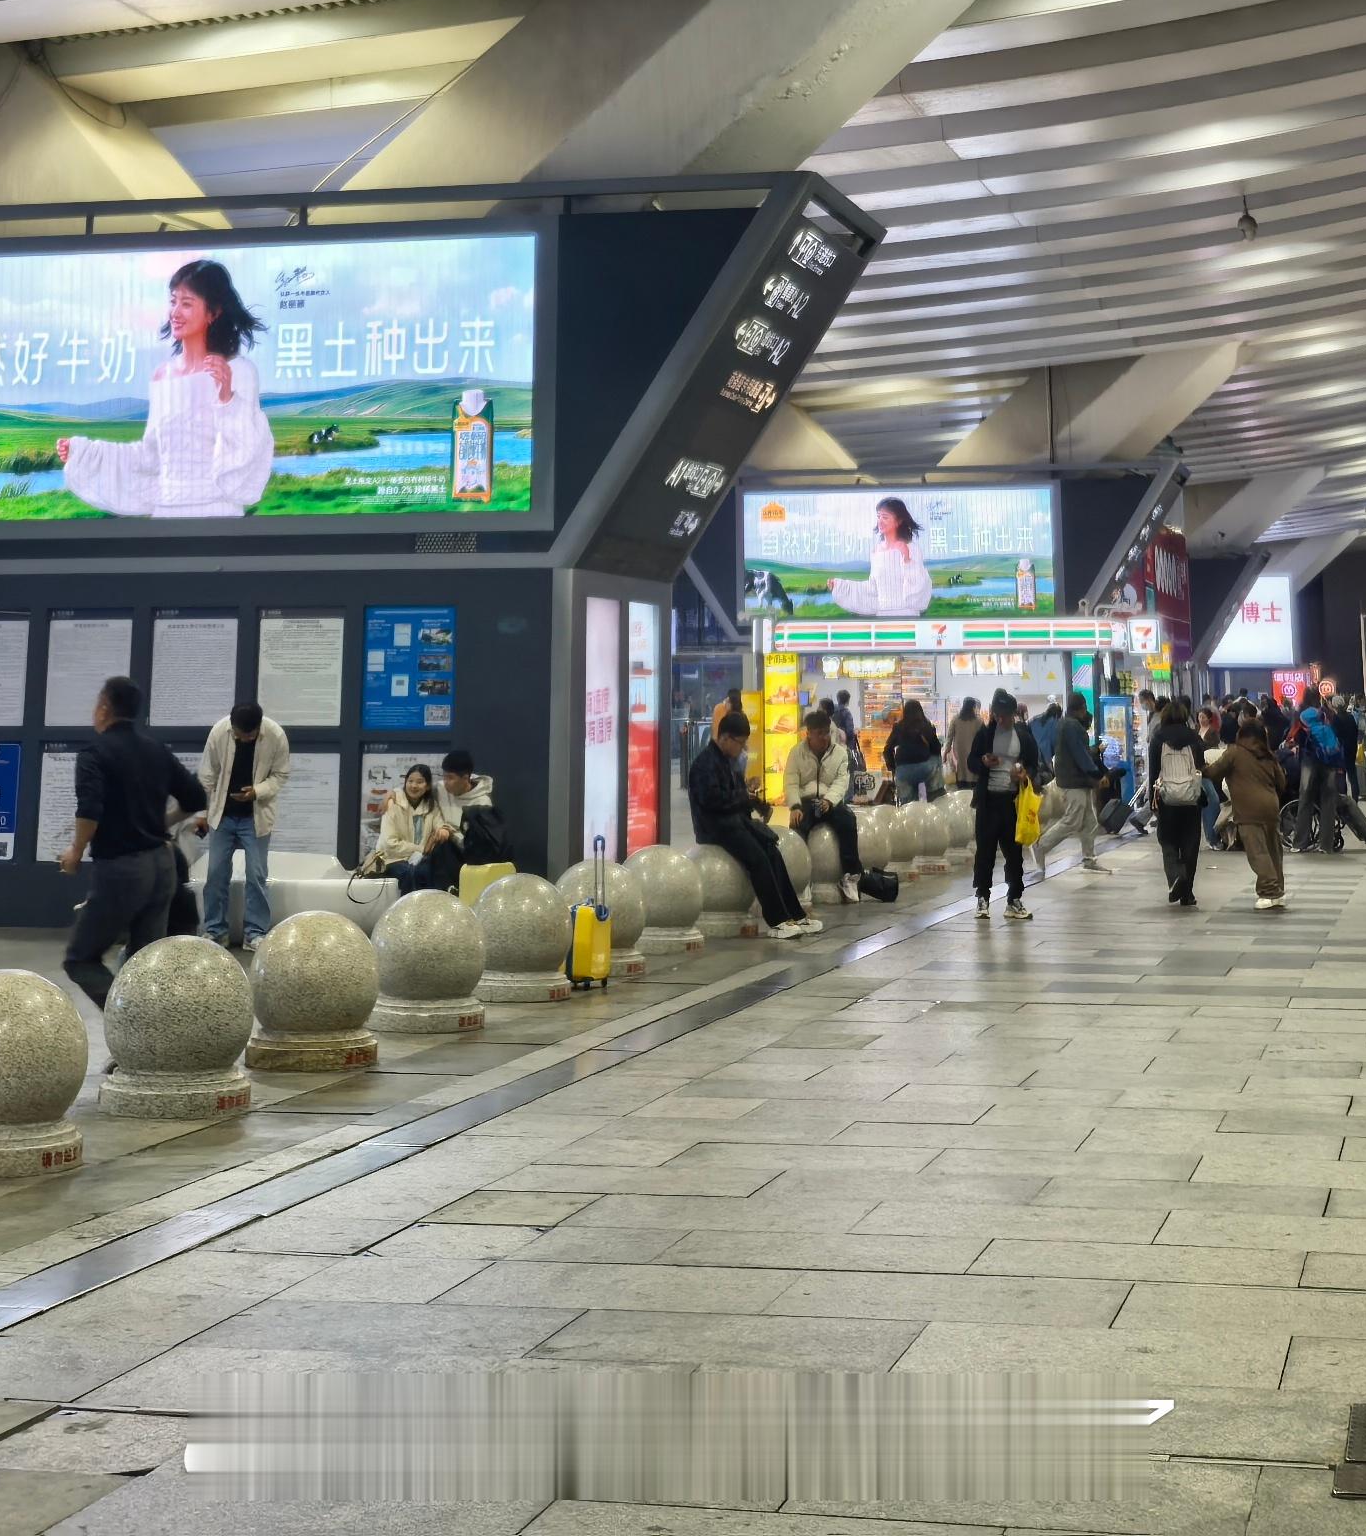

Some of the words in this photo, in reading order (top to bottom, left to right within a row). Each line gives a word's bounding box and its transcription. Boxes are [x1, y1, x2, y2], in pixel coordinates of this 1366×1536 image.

[786, 291, 811, 319] A2
[275, 317, 496, 379] 黑土种出来
[766, 337, 792, 365] A2
[663, 460, 690, 487] A1
[762, 529, 869, 556] 自然好牛奶
[930, 526, 1033, 554] 黑土种出来
[1241, 600, 1282, 624] 博士
